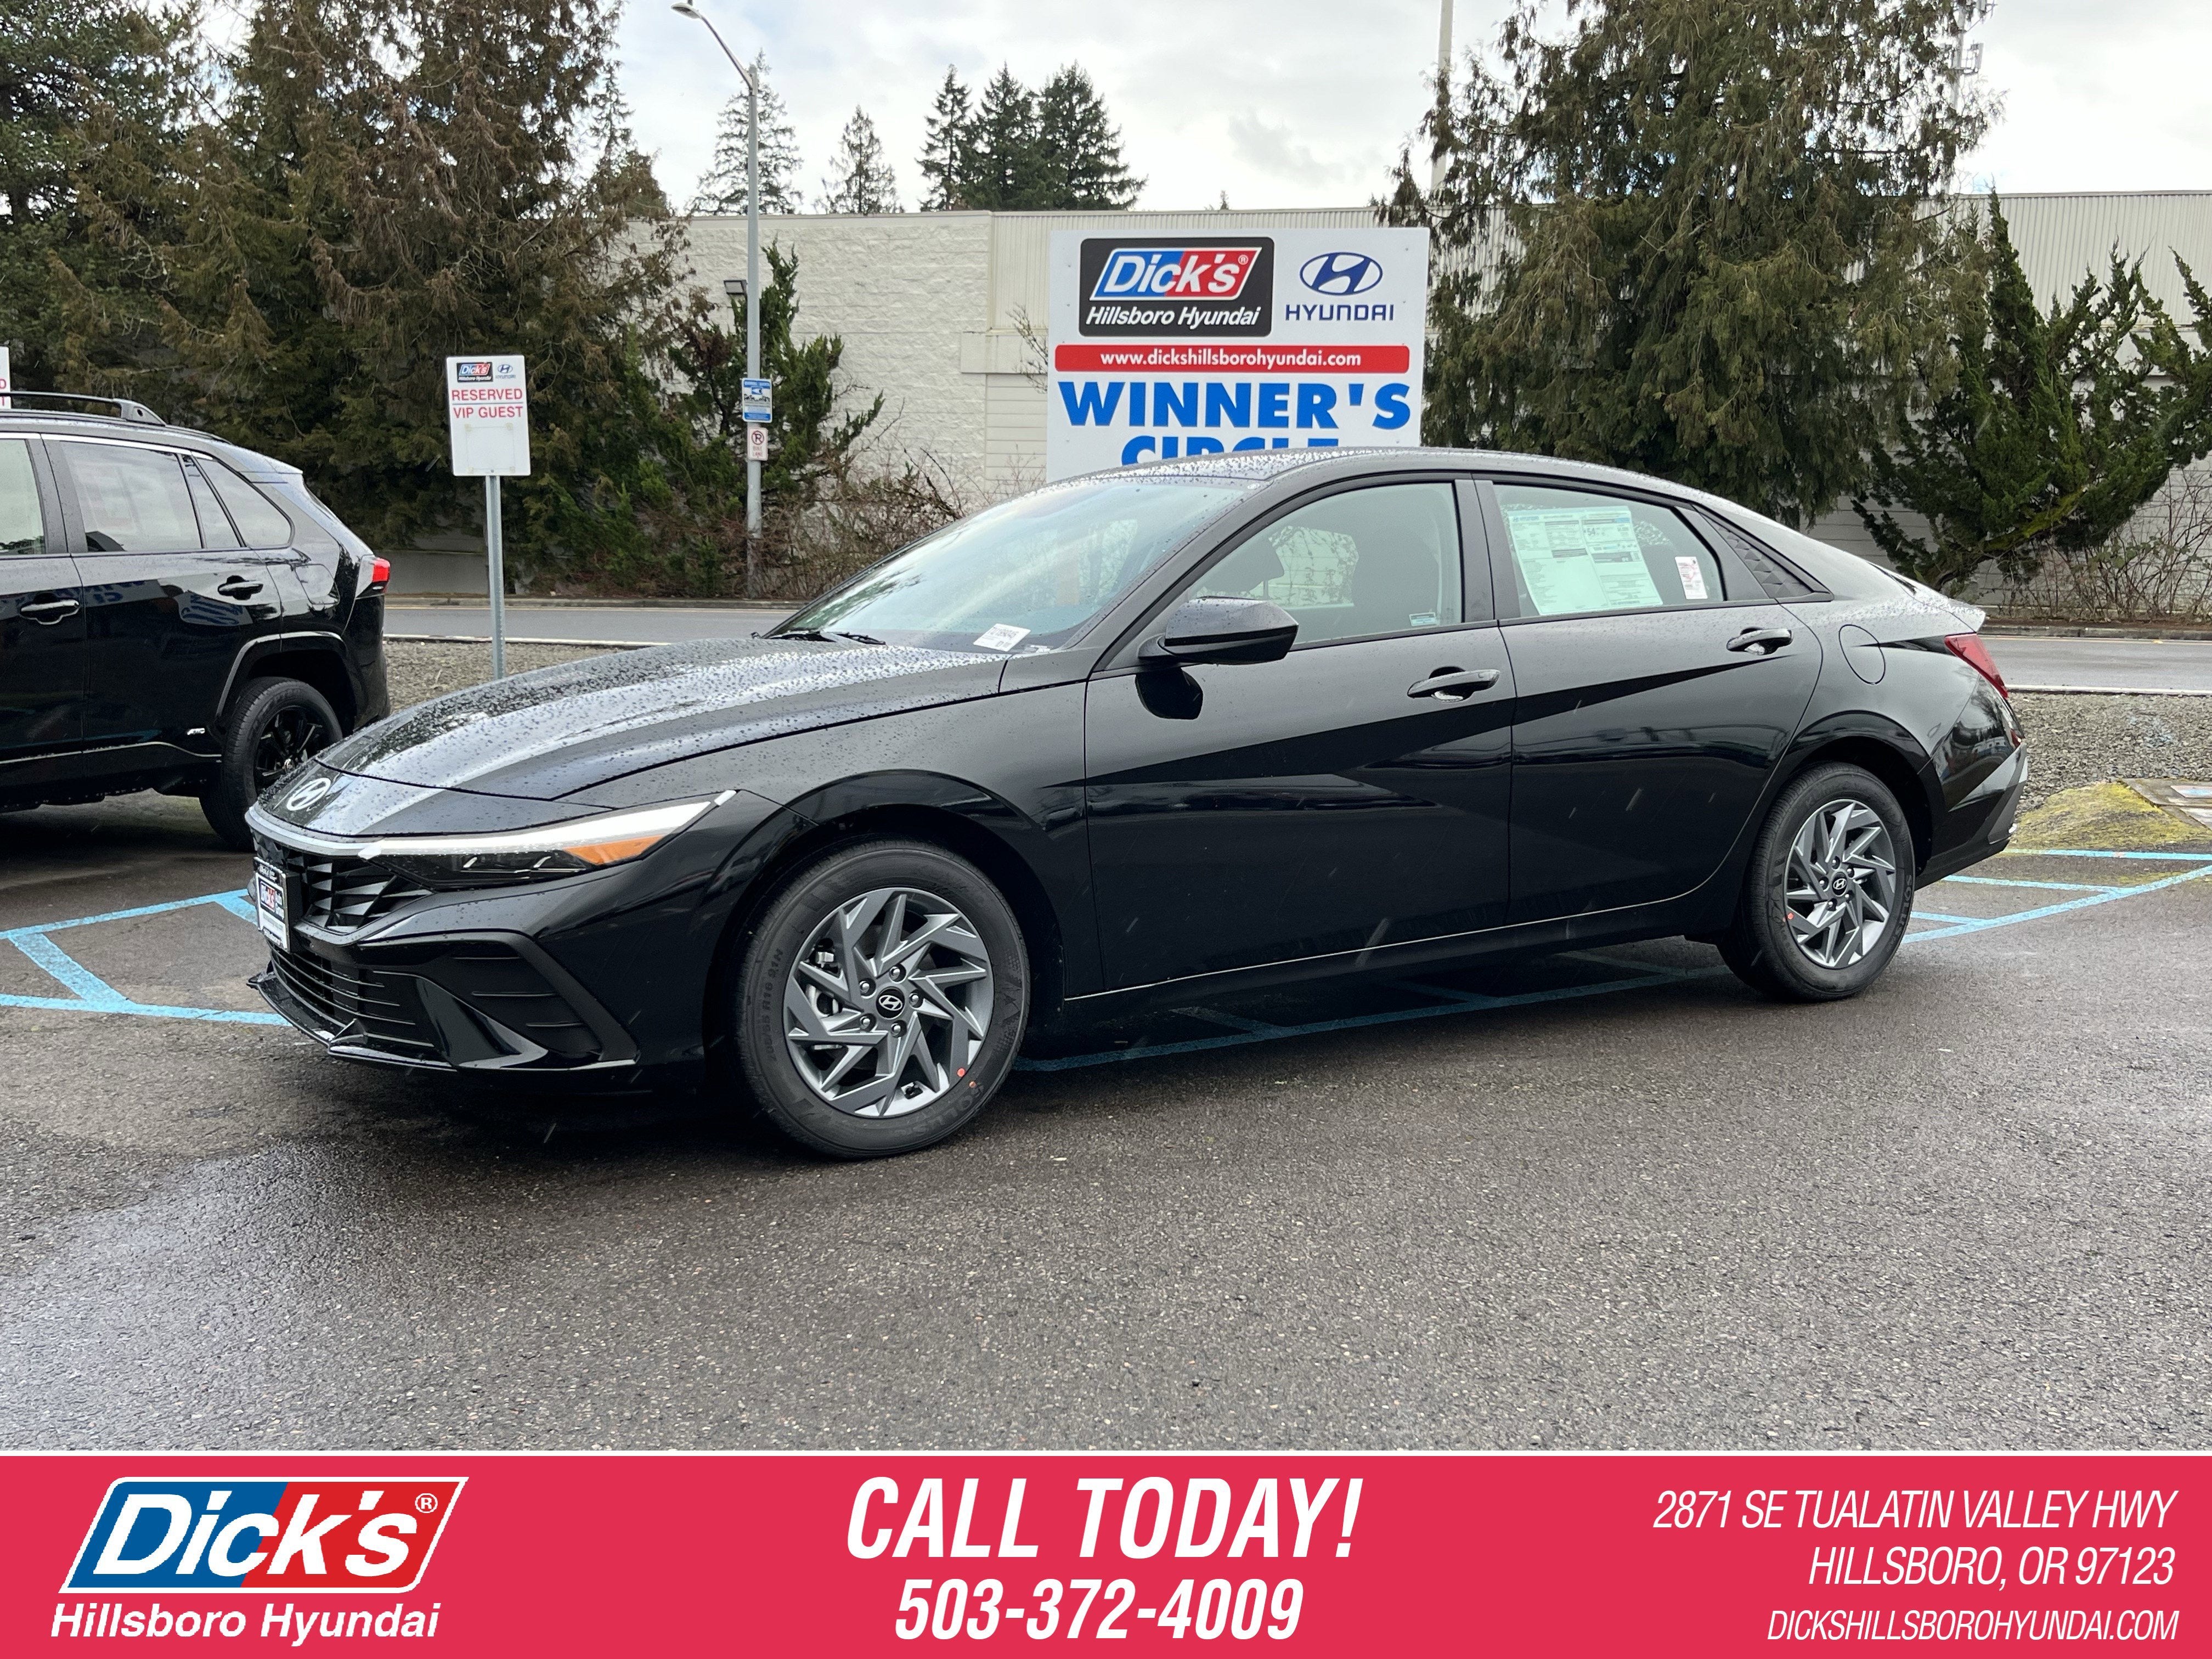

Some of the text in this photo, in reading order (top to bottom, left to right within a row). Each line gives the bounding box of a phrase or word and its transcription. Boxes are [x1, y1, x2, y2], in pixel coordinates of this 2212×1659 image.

[1103, 253, 1240, 294] Dick's
[1085, 306, 1261, 330] Hillsboro Hyundai
[1285, 304, 1394, 321] HYUNDAI
[1101, 348, 1361, 370] www.dickshillsborohyundai.com
[452, 388, 523, 401] RESERVED
[1058, 381, 1411, 430] WINNER'S
[453, 406, 523, 419] VIP GUEST
